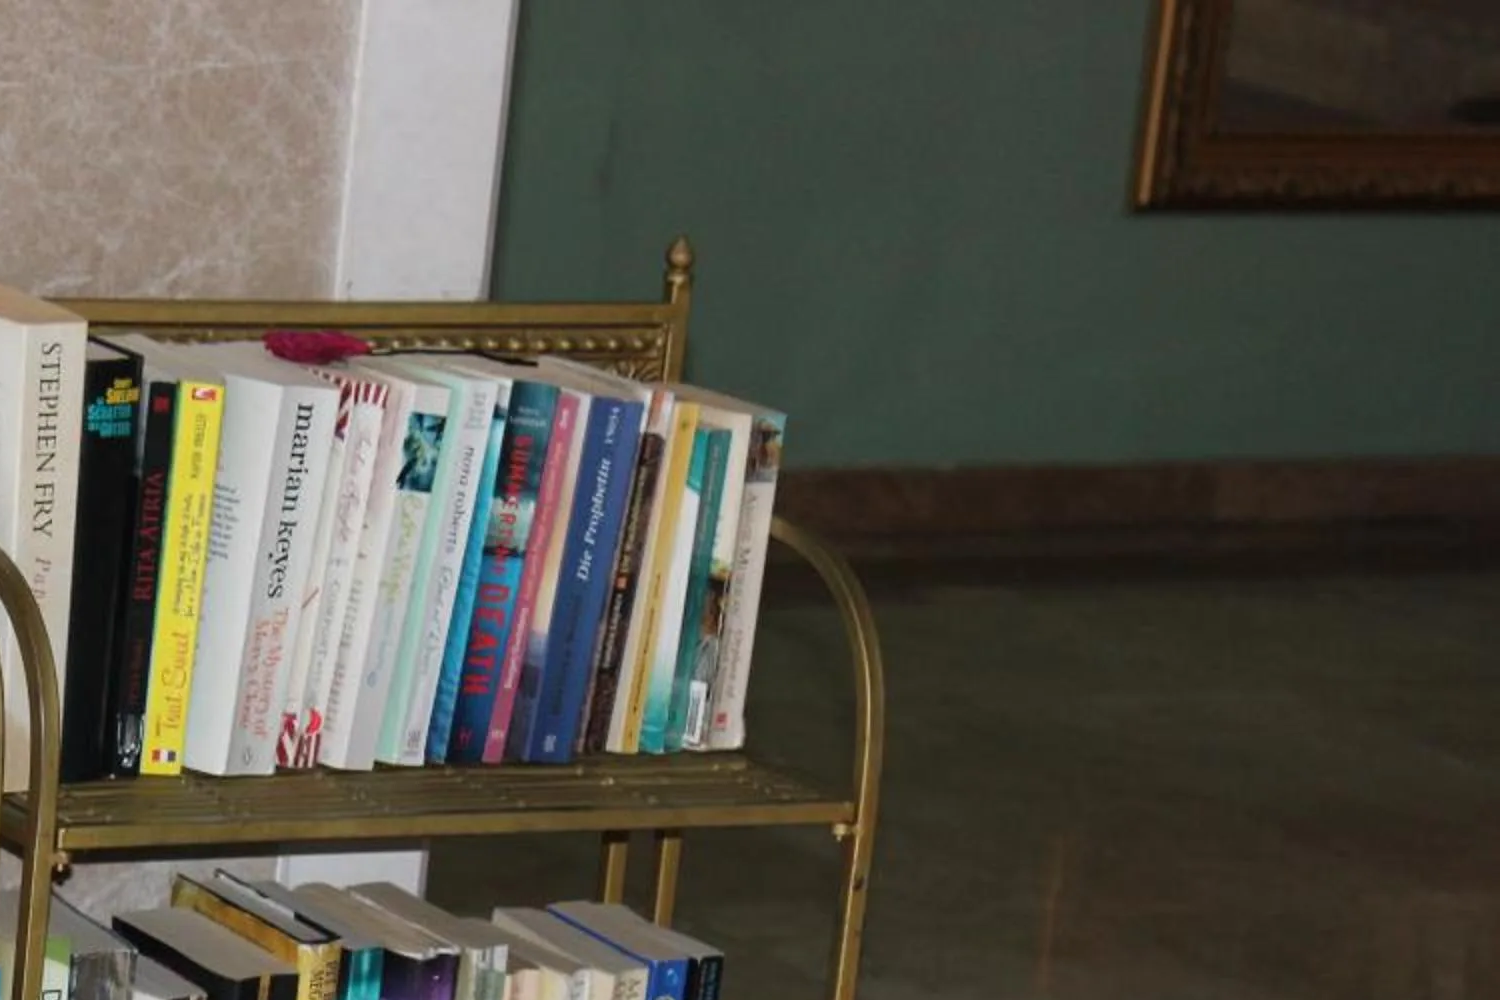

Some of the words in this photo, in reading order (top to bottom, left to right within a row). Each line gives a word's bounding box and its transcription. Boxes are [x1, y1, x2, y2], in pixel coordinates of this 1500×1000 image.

[35, 343, 62, 472] STEPHEN
[282, 402, 314, 513] marian
[459, 446, 476, 485] nora
[32, 482, 54, 538] FRY
[444, 491, 469, 554] roberts
[581, 459, 612, 544] Prophetin
[268, 520, 298, 599] keyes
[576, 550, 592, 580] Die
[275, 609, 290, 631] The
[463, 584, 509, 695] DEATH
[254, 720, 267, 738] of
[309, 969, 324, 999] MEG
